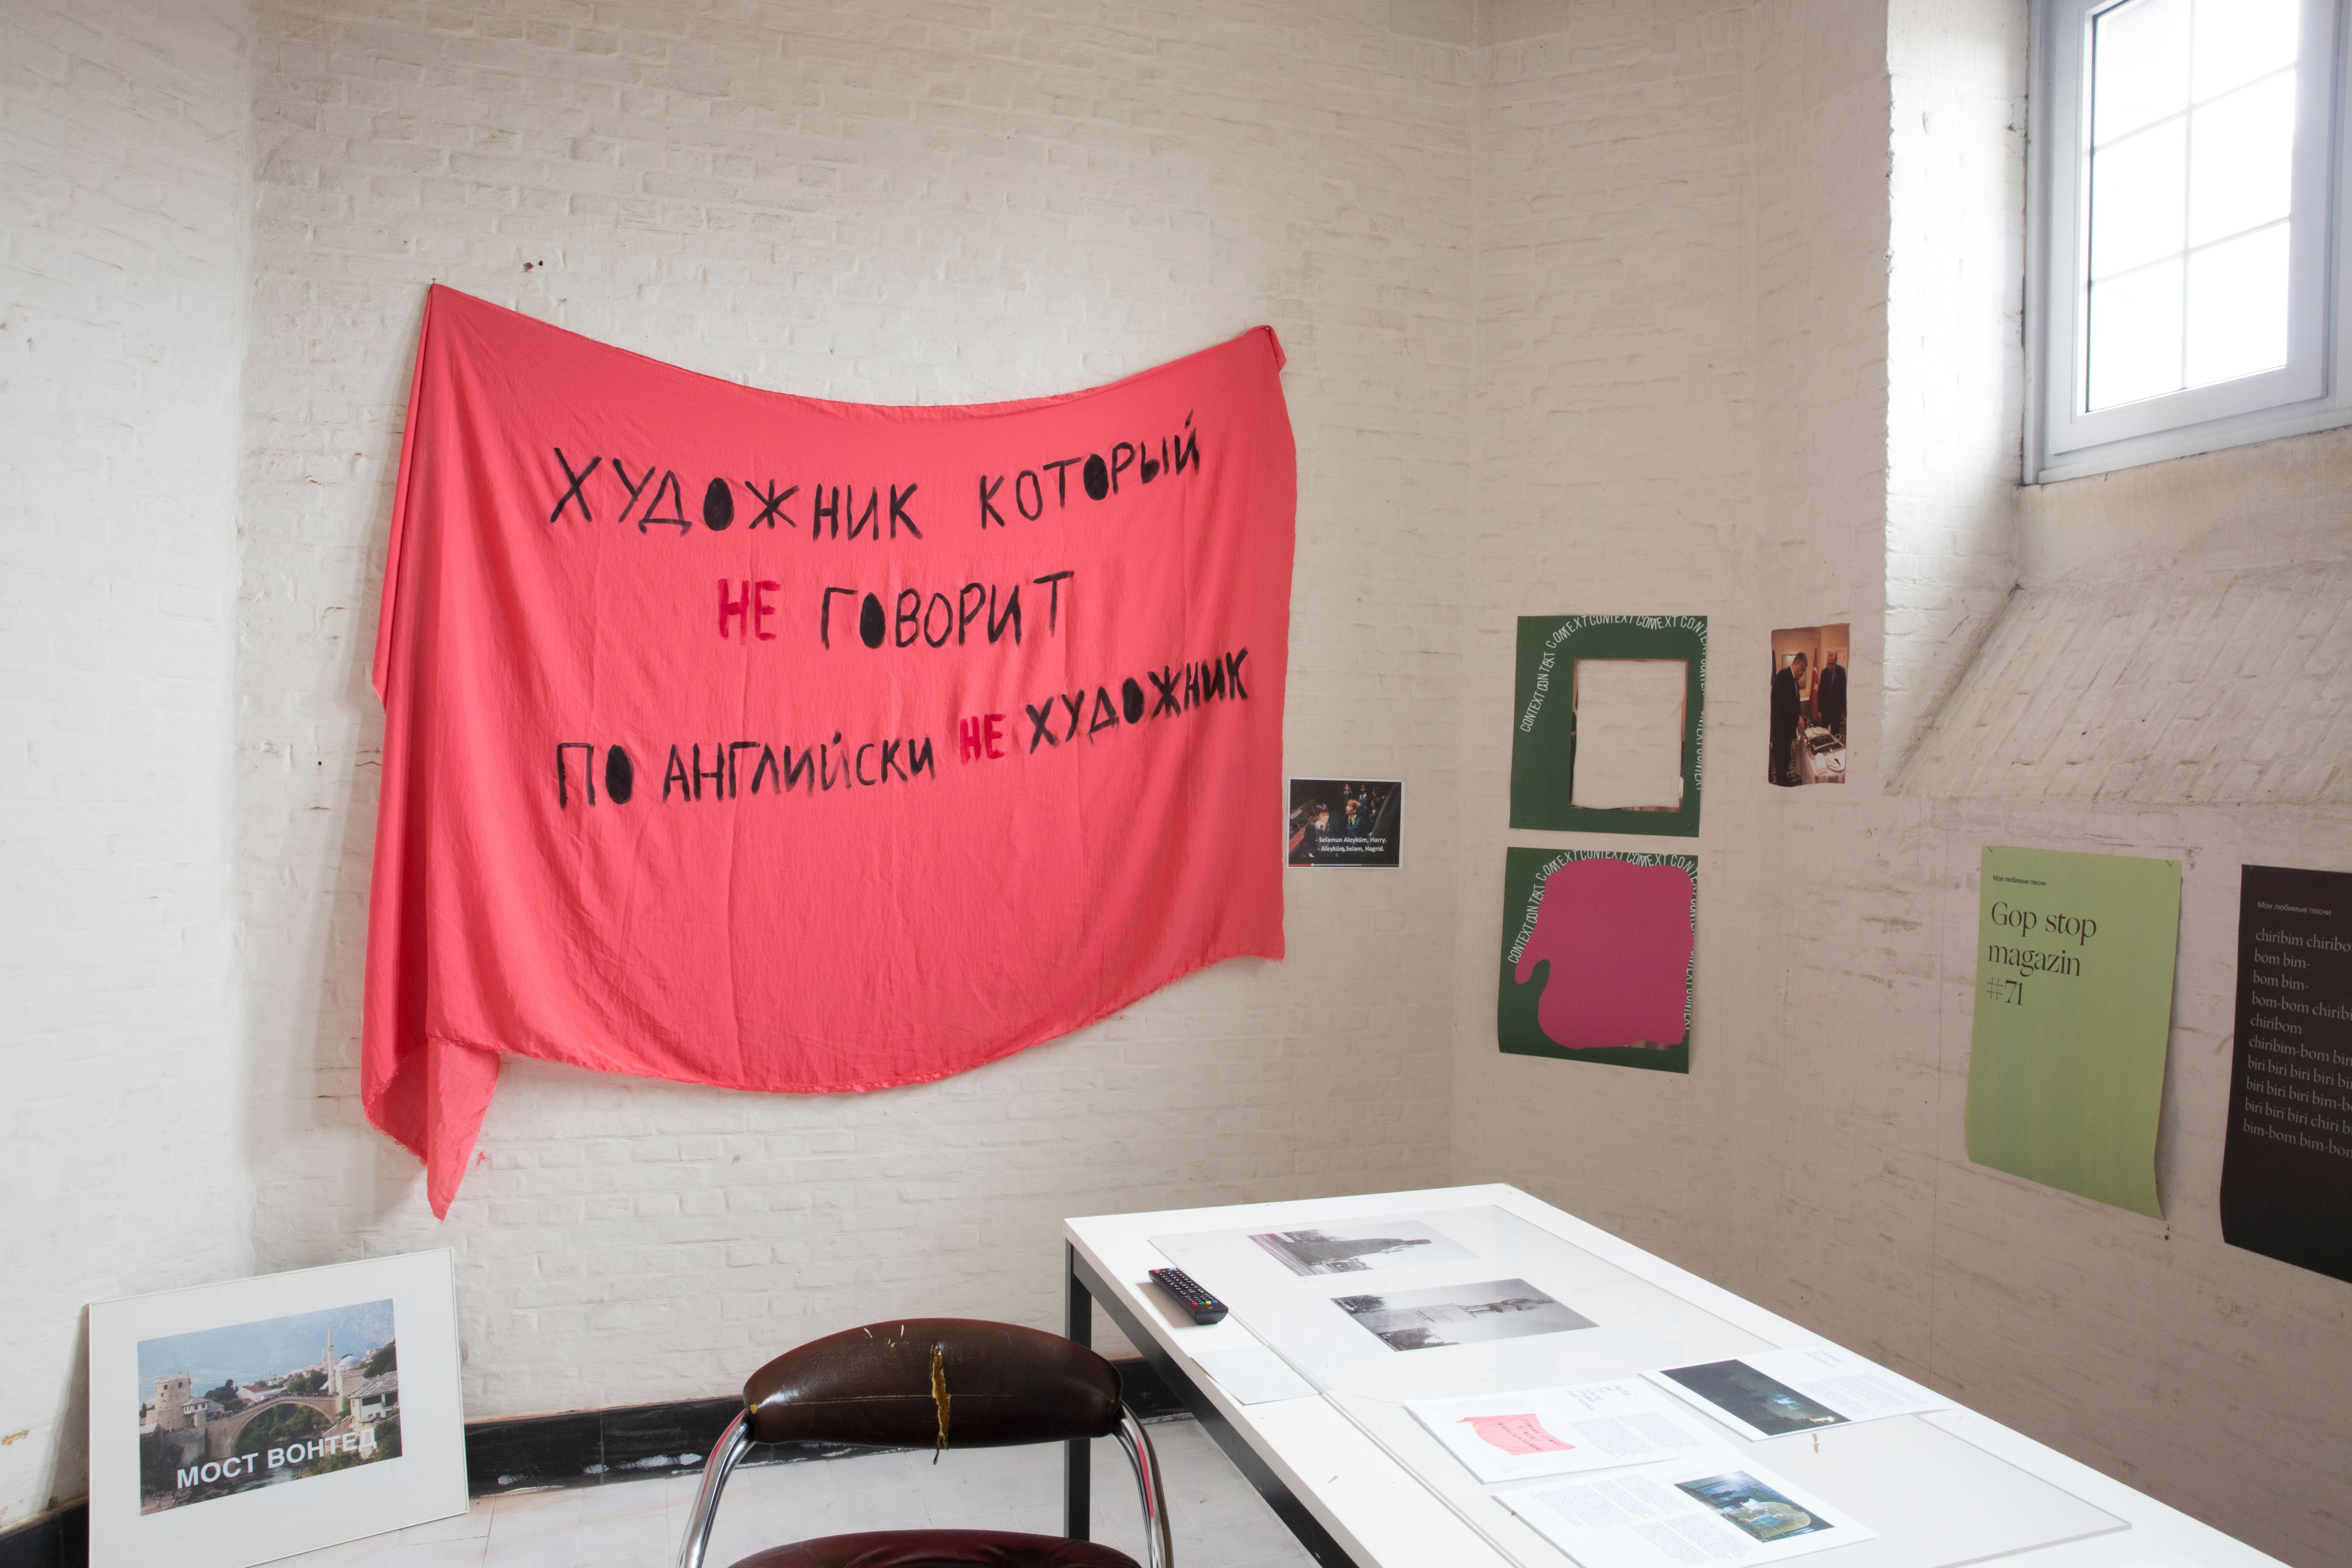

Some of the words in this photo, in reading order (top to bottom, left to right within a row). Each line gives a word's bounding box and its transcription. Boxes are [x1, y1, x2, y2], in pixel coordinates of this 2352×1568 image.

[550, 447, 923, 540] ХУДОЖНИК
[980, 410, 1200, 528] КОТОРЫЙ
[717, 579, 781, 645] НЕ
[821, 570, 1075, 650] ГОВОРИТ
[1520, 690, 1545, 732] CONTEXT
[557, 741, 634, 810] ПО
[662, 731, 935, 803] АНГЛИЙСКИ
[959, 713, 1006, 766] НЕ
[1026, 647, 1250, 754] ХУДОЖНИК
[1991, 902, 2037, 937] Gop
[2045, 913, 2097, 946] stop
[2258, 901, 2273, 909] Мои
[2274, 904, 2307, 913] любимые
[2309, 907, 2332, 915] песни
[1508, 922, 1534, 963] CONTEXT
[2256, 928, 2303, 946] chiribim
[2306, 934, 2352, 952] chiribo
[1988, 944, 2080, 977] magazin
[2254, 948, 2280, 965] bom
[2283, 952, 2311, 969] bim-
[1987, 977, 2022, 1006] #71
[2253, 969, 2278, 987] bom
[2281, 974, 2309, 991] bim-
[2252, 991, 2309, 1013] bom-bom
[2250, 1013, 2302, 1035] chiribom
[2249, 1034, 2329, 1062] chiribim-bom
[2248, 1054, 2265, 1071] biri
[2268, 1059, 2287, 1076] biri
[2290, 1063, 2310, 1081] biri
[2314, 1068, 2334, 1085] biri
[2247, 1076, 2264, 1092] biri
[2267, 1080, 2286, 1098] biri
[2289, 1085, 2309, 1102] biri
[2312, 1090, 2352, 1111] bim-b
[2245, 1097, 2262, 1114] biri
[2266, 1102, 2285, 1119] biri
[2288, 1107, 2307, 1125] biri
[2311, 1114, 2339, 1132] chiri
[2243, 1118, 2296, 1144] bim-bom
[176, 1452, 259, 1489] МОСТ
[267, 1428, 378, 1469] ВОНТЕД
